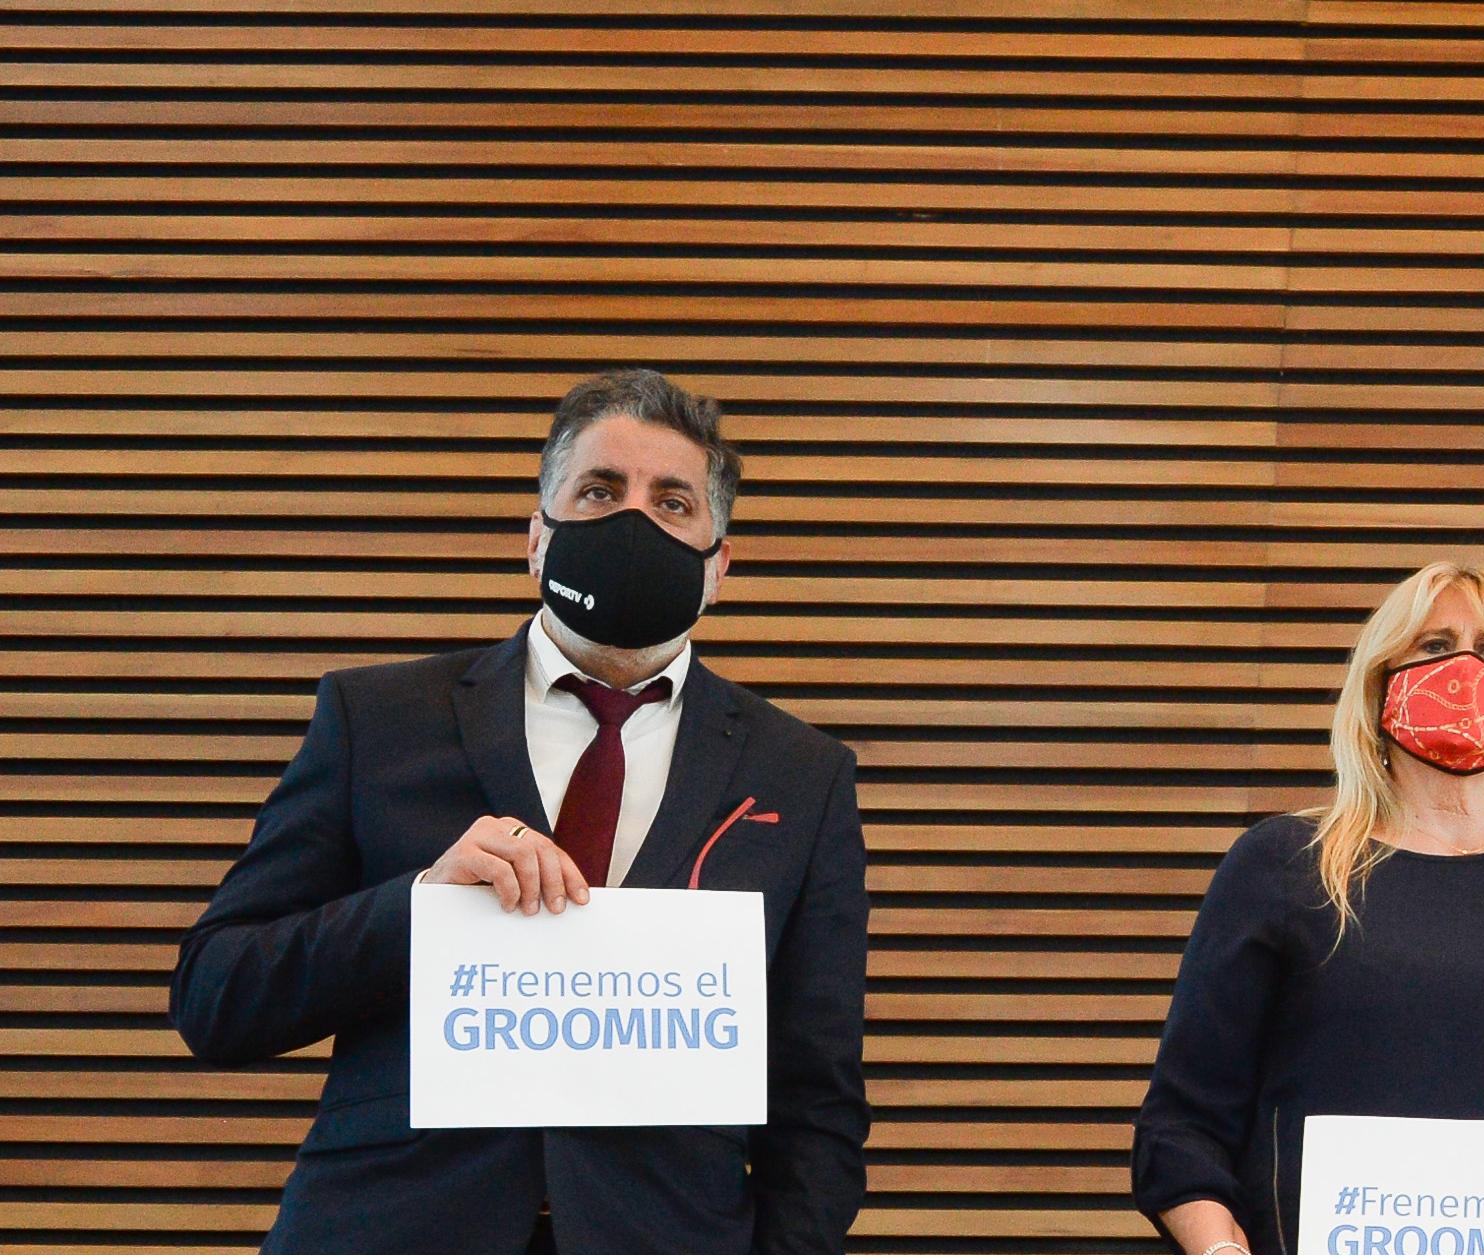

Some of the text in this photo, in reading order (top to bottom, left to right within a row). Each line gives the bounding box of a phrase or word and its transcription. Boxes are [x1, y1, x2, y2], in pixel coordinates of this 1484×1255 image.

[449, 962, 732, 998] #Frenemos el
[443, 1006, 739, 1051] GROOMING
